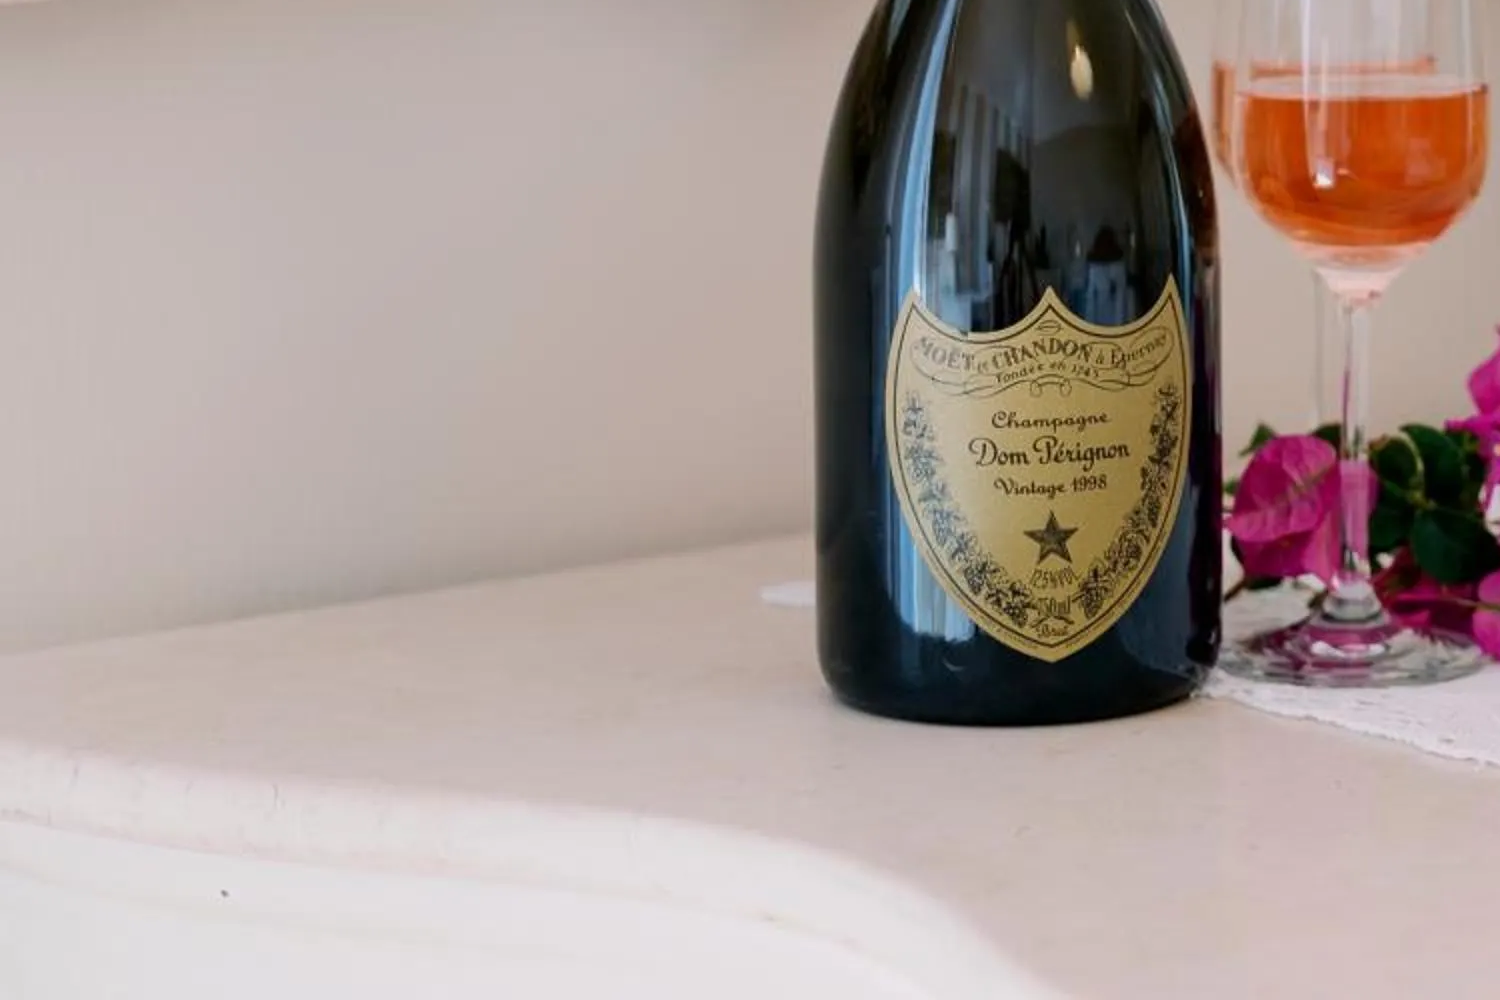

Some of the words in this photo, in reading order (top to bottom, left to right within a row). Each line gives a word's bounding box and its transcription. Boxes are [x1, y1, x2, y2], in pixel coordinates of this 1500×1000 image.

[991, 337, 1093, 369] CHANDON
[991, 410, 1112, 434] Champagne
[968, 437, 1031, 467] Dom
[1032, 435, 1131, 472] Pérignon
[993, 476, 1067, 500] Vintage
[1071, 474, 1108, 493] 1998
